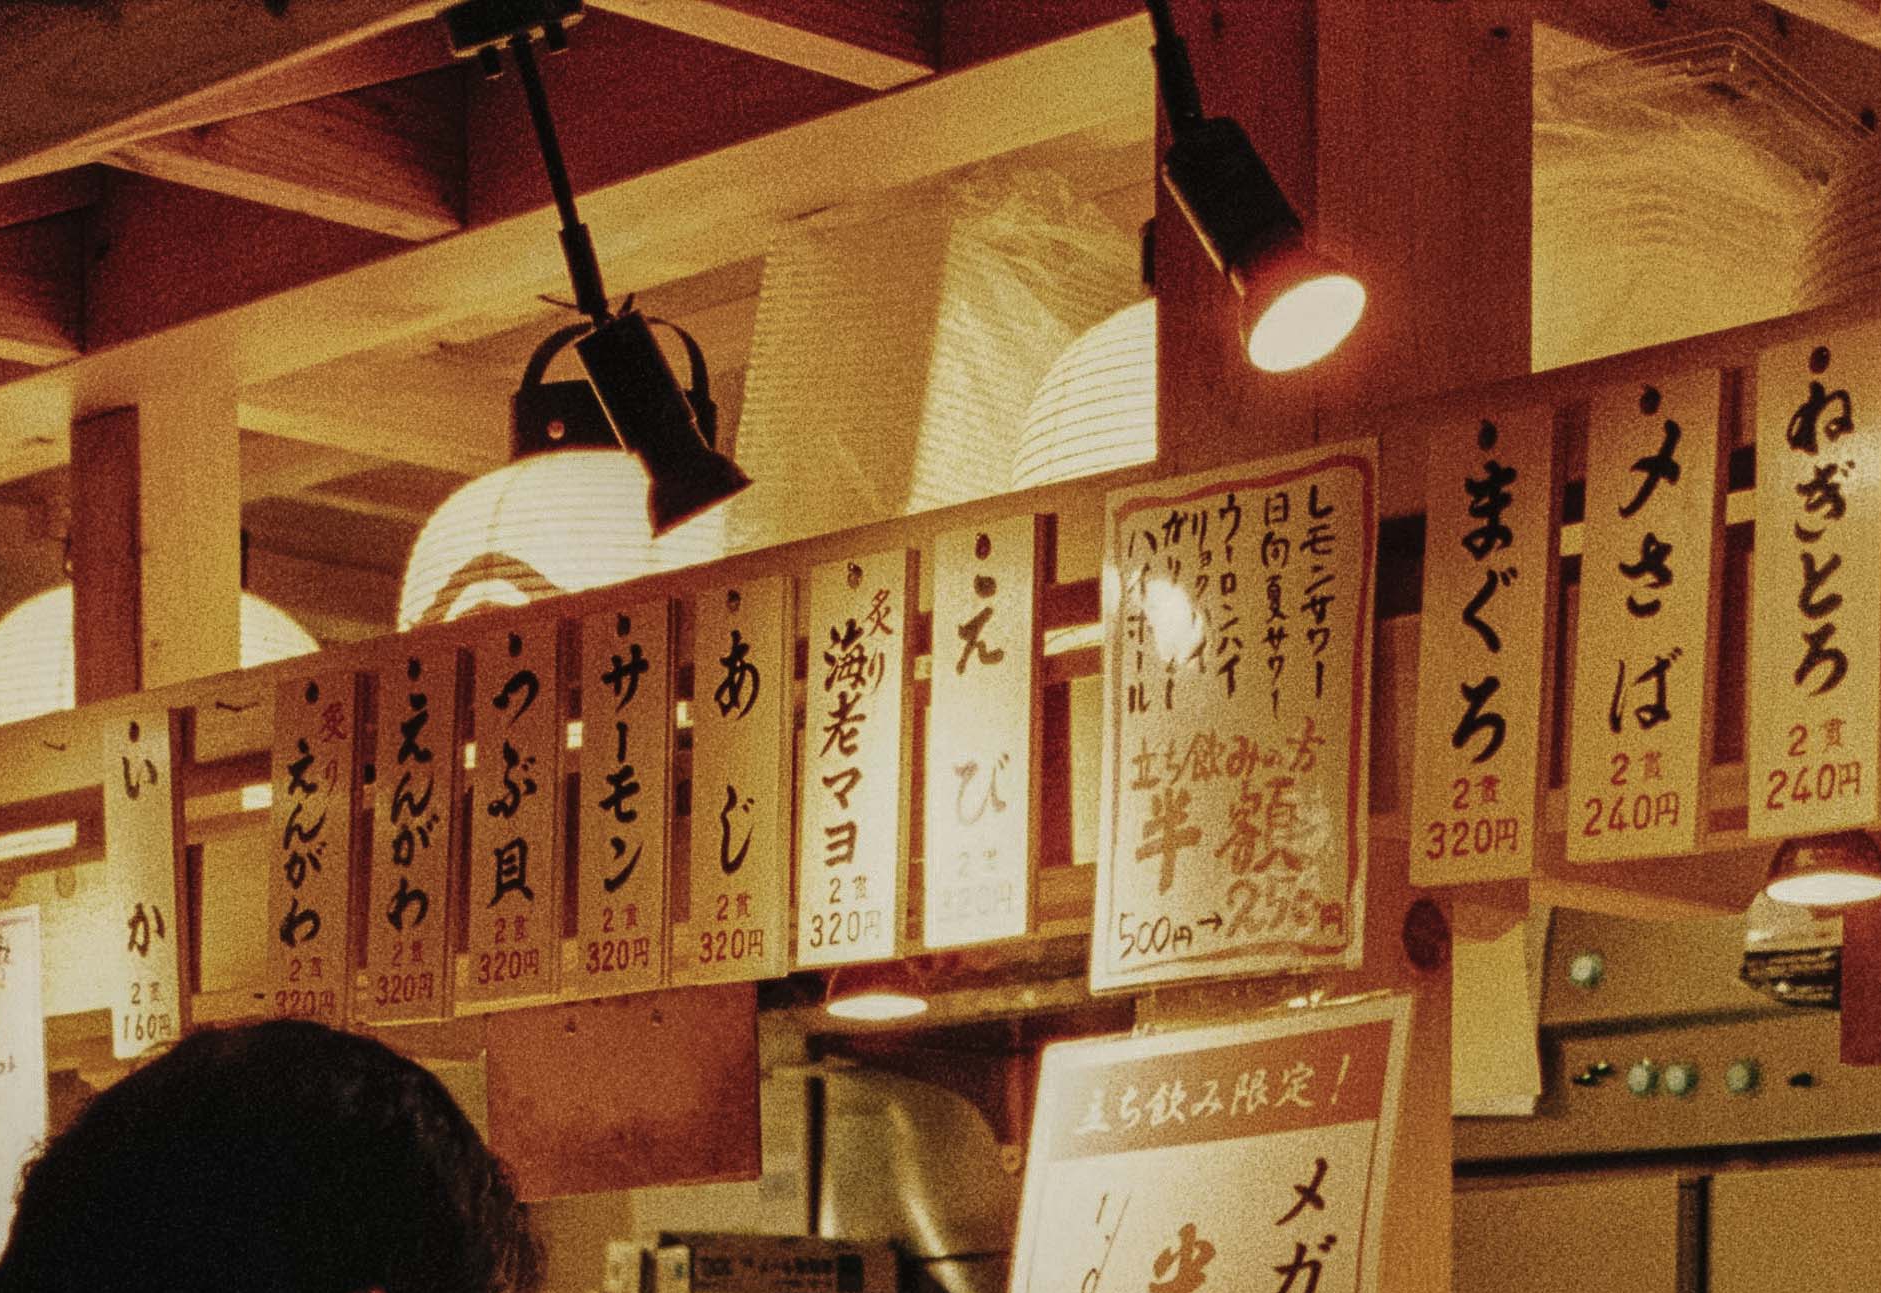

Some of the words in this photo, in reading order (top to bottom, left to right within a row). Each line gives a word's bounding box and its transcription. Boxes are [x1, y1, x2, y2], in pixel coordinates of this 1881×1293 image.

[865, 588, 893, 695] 炙り
[1217, 492, 1244, 699] ウーロンハイ
[1261, 492, 1291, 720] 日向夏サワー
[1300, 484, 1336, 699] レモンサワー
[1451, 459, 1518, 766] まぐろ
[1785, 379, 1857, 698] ねぎとろ
[487, 669, 540, 910] つぶ貝
[599, 641, 650, 894] サーモン
[713, 630, 761, 875] あじ
[819, 618, 870, 870] 海老マヨ
[953, 575, 1012, 827] えび
[1765, 760, 1863, 812] 240円
[121, 755, 166, 957] いか
[279, 737, 328, 947] えんがわ
[387, 692, 439, 932] えんがわ
[1135, 777, 1304, 896] 半額
[1426, 816, 1519, 862] 320円
[1582, 792, 1681, 838] 240円
[375, 971, 434, 1006] 320円
[477, 948, 540, 985] 320円
[585, 937, 651, 976] 320円
[698, 928, 765, 964] 320円
[809, 910, 882, 951] 320円
